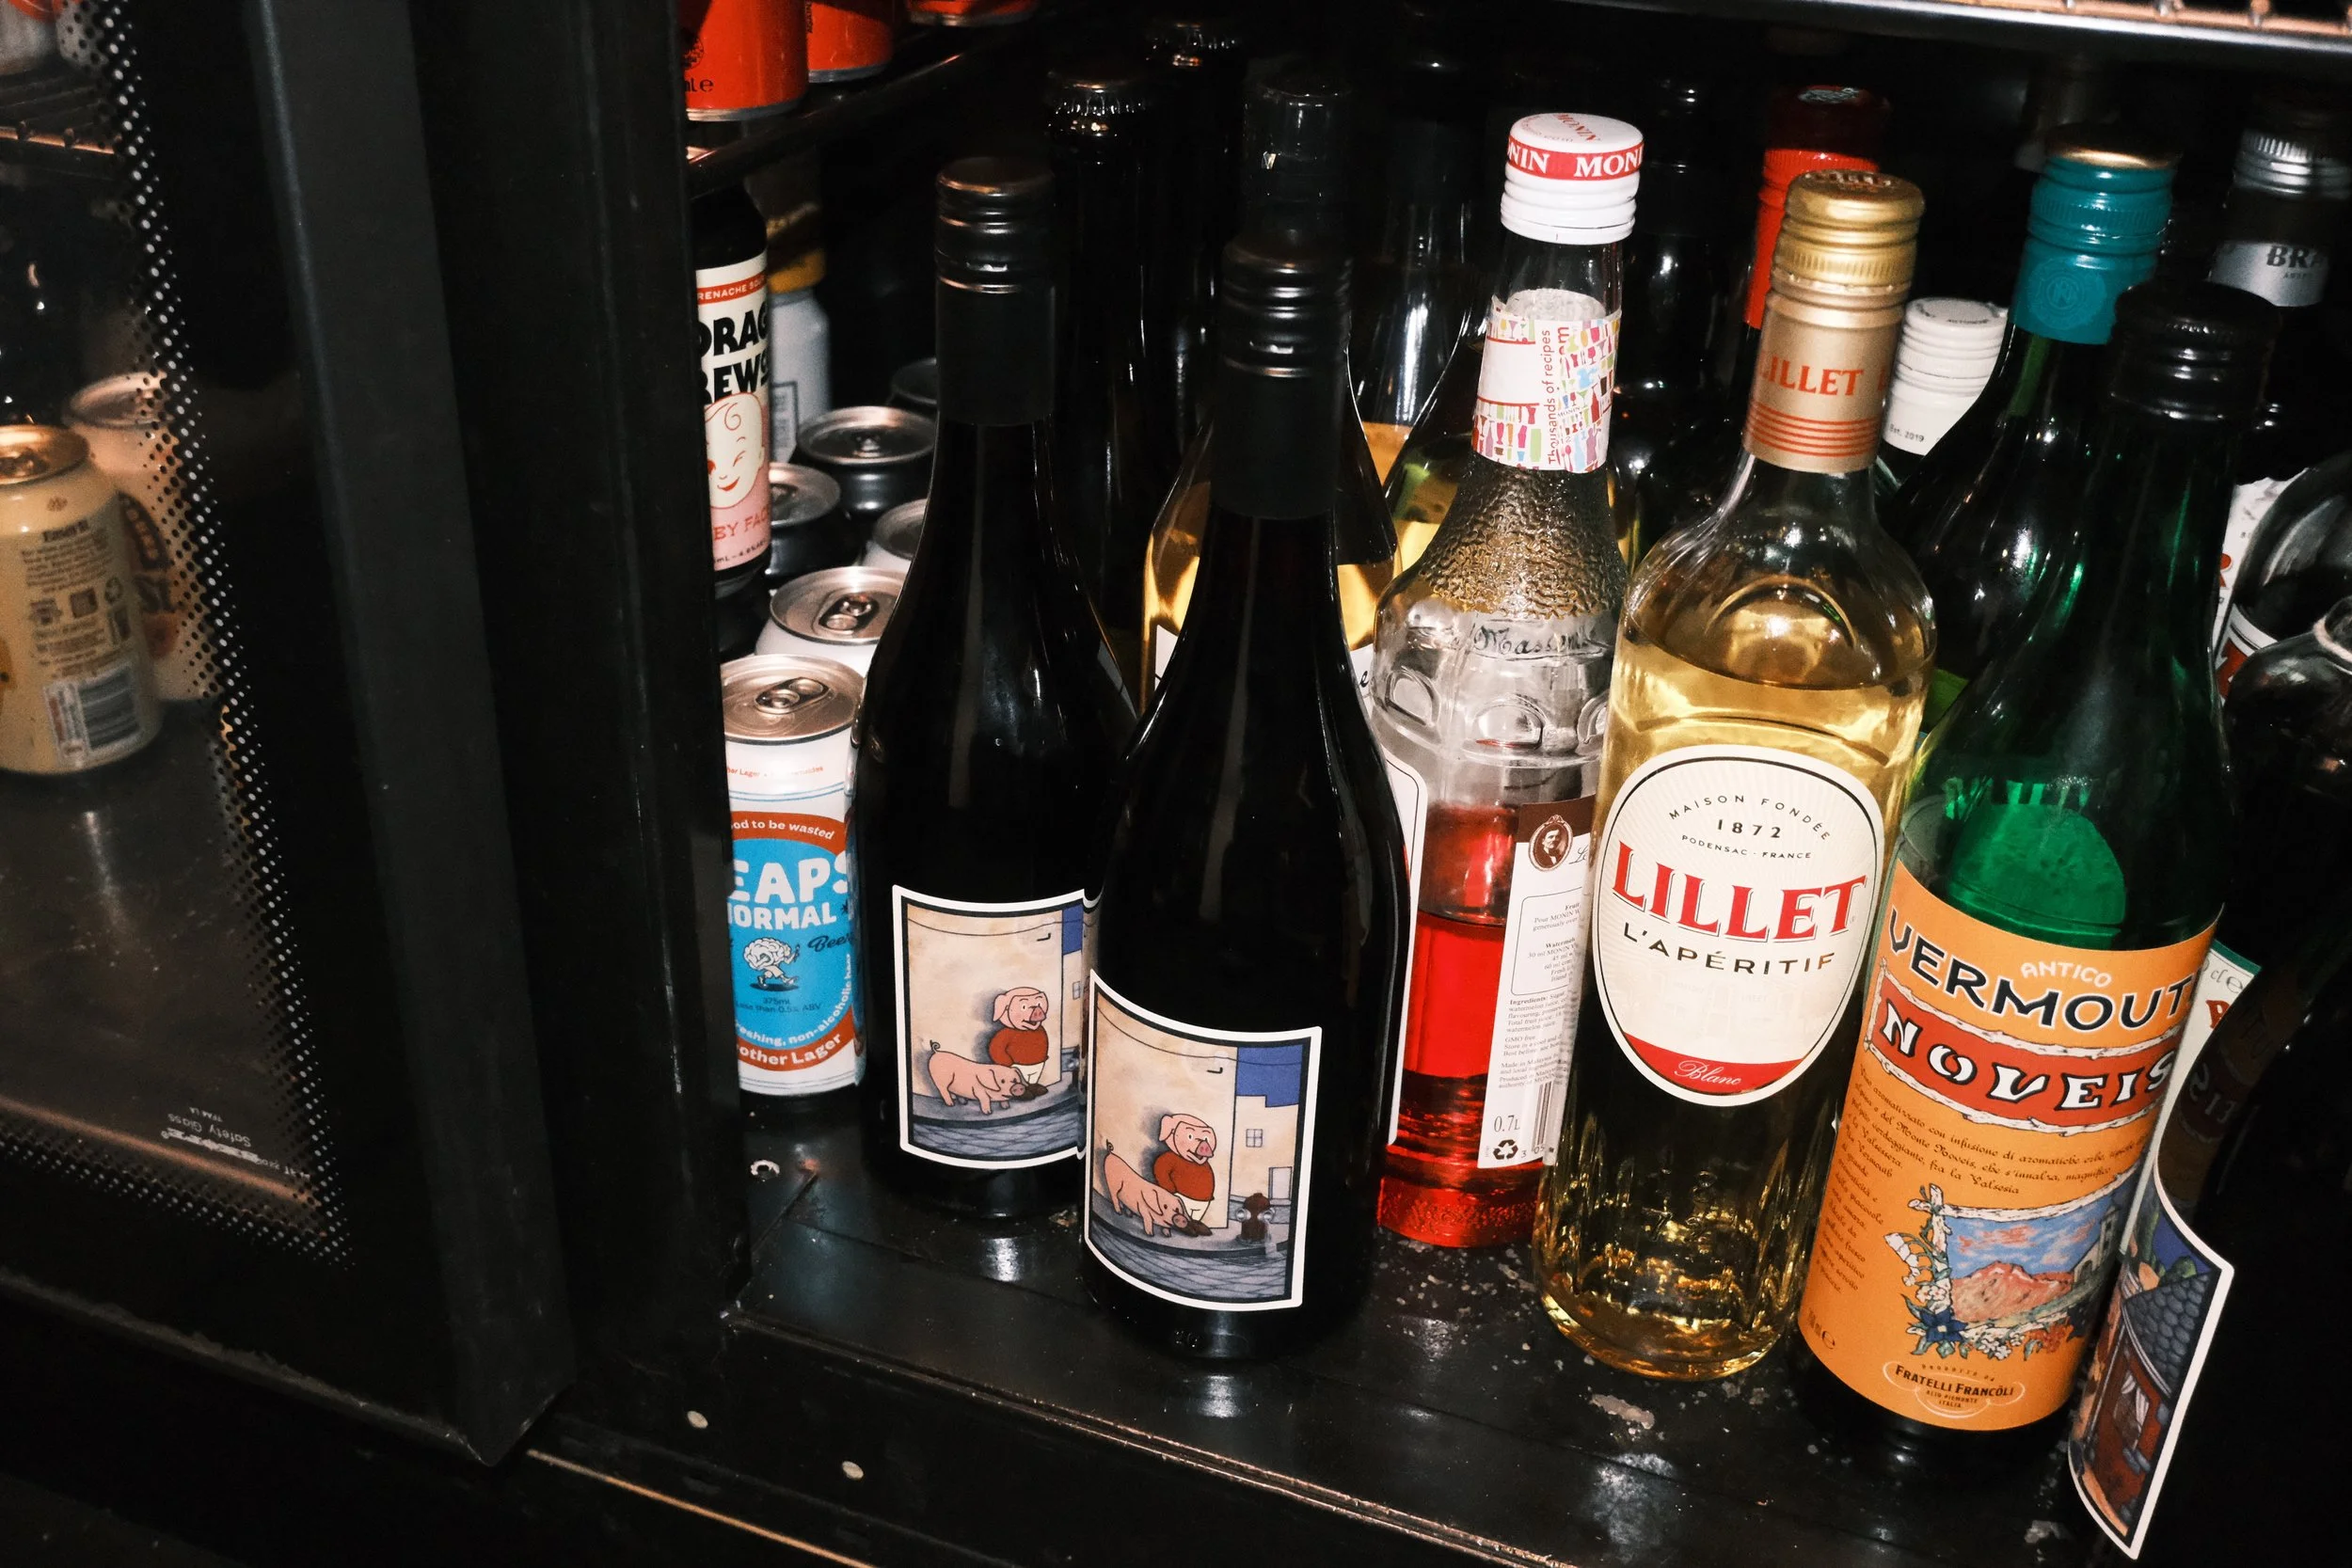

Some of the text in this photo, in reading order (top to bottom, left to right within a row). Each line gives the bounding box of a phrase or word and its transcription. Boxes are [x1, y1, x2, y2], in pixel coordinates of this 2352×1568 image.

[1540, 330, 1553, 375] recipes
[1541, 378, 1554, 394] of
[1904, 432, 1925, 442] 2019
[731, 820, 835, 840] od to be wasted
[1669, 795, 1831, 840] MAISON FONDÉE
[1717, 819, 1782, 839] 1872
[1681, 834, 1812, 860] PODENSAC FRANCE
[1612, 840, 1867, 943] LILLET
[1623, 922, 1836, 974] L'APÉRITIF
[1888, 909, 2195, 1032] VERMOUT
[2021, 960, 2112, 988] ANTICO
[738, 1034, 841, 1066] other Lager
[1883, 1000, 2175, 1111] NOVEIS
[1674, 1059, 1742, 1085] Blanc
[1929, 1127, 1947, 1139] con
[1950, 1135, 1999, 1158] infusione
[2002, 1150, 2015, 1161] di
[2019, 1153, 2081, 1165] aromatiche
[1929, 1160, 1945, 1175] fra
[1949, 1167, 1963, 1180] la
[1970, 1174, 2020, 1195] Valsesia
[1981, 1163, 2000, 1175] che
[1895, 1364, 1953, 1393] FRATELLI
[1939, 1400, 1963, 1409] ITALIA
